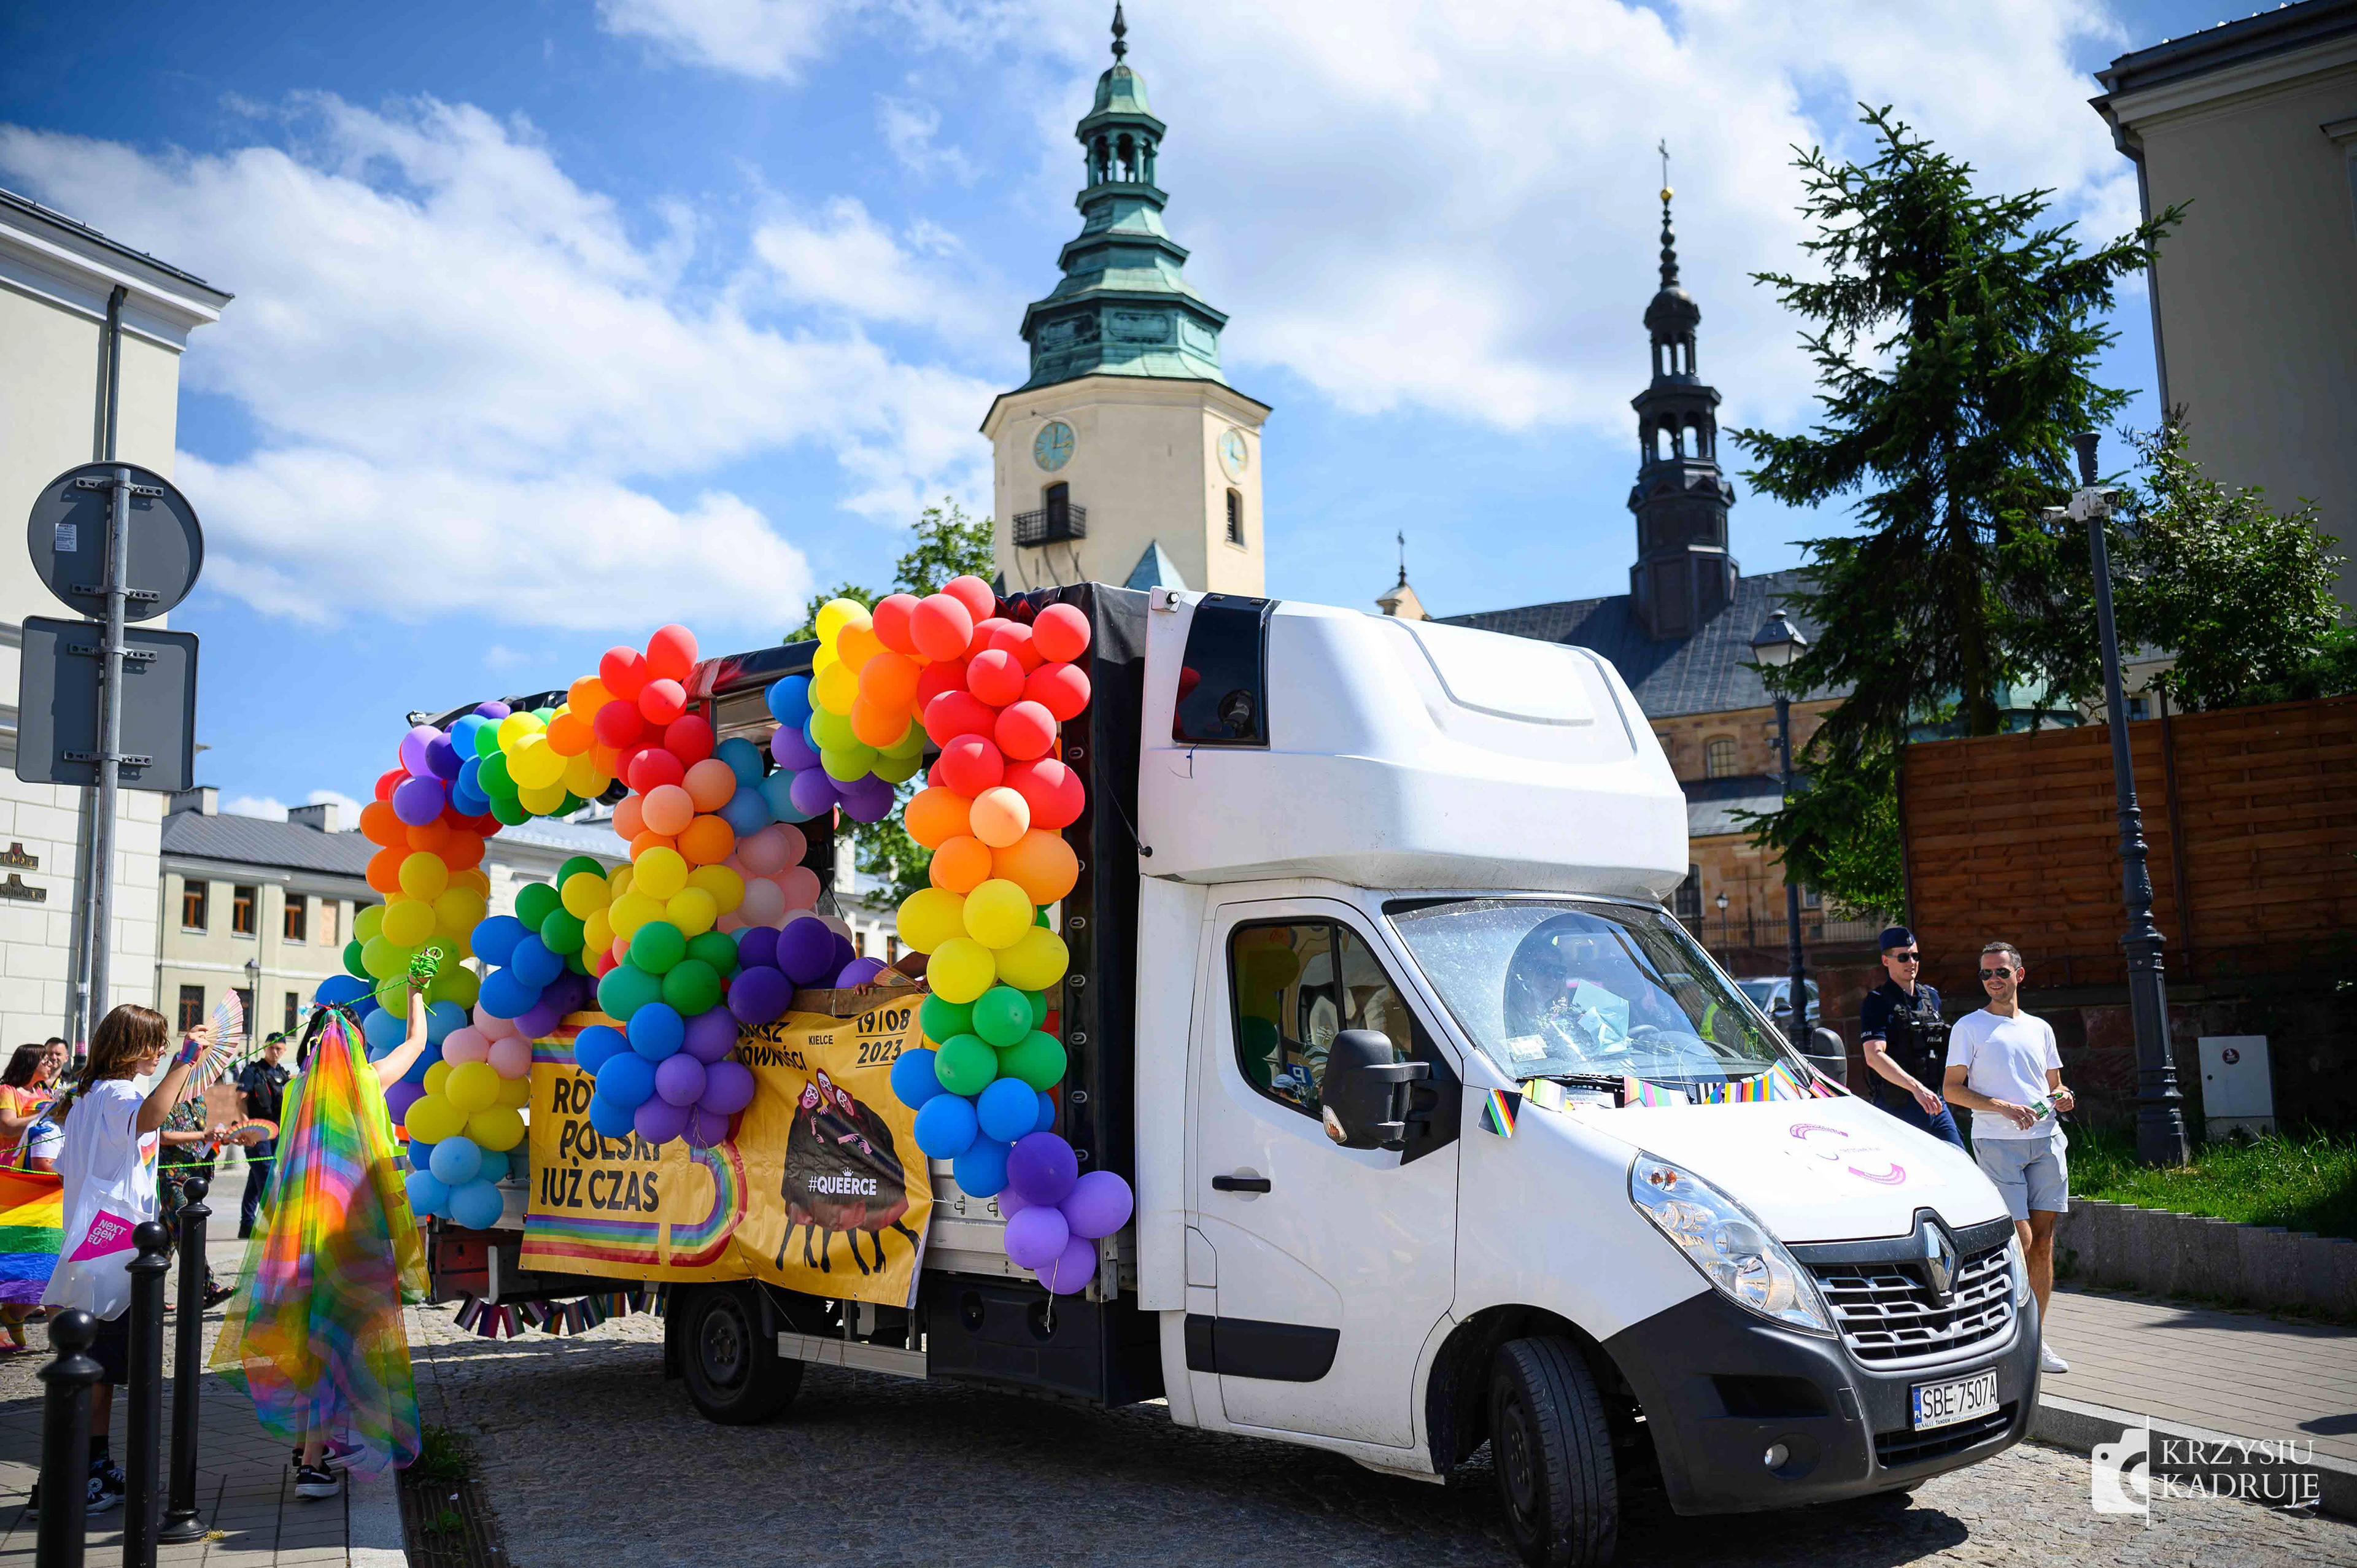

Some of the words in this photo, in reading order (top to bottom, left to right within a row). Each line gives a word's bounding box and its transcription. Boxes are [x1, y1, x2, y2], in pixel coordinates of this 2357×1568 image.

[808, 1035, 834, 1045] KIELCE
[857, 1038, 904, 1064] 2023
[540, 1156, 583, 1208] JUŻ
[588, 1169, 660, 1213] CZAS
[808, 1175, 877, 1195] #QUEERCE
[87, 1234, 103, 1245] EU
[1922, 1385, 1954, 1419] SBE
[1958, 1375, 1997, 1413] 7507A
[1914, 1410, 1921, 1419] PL
[1916, 1421, 1934, 1429] RENAULT
